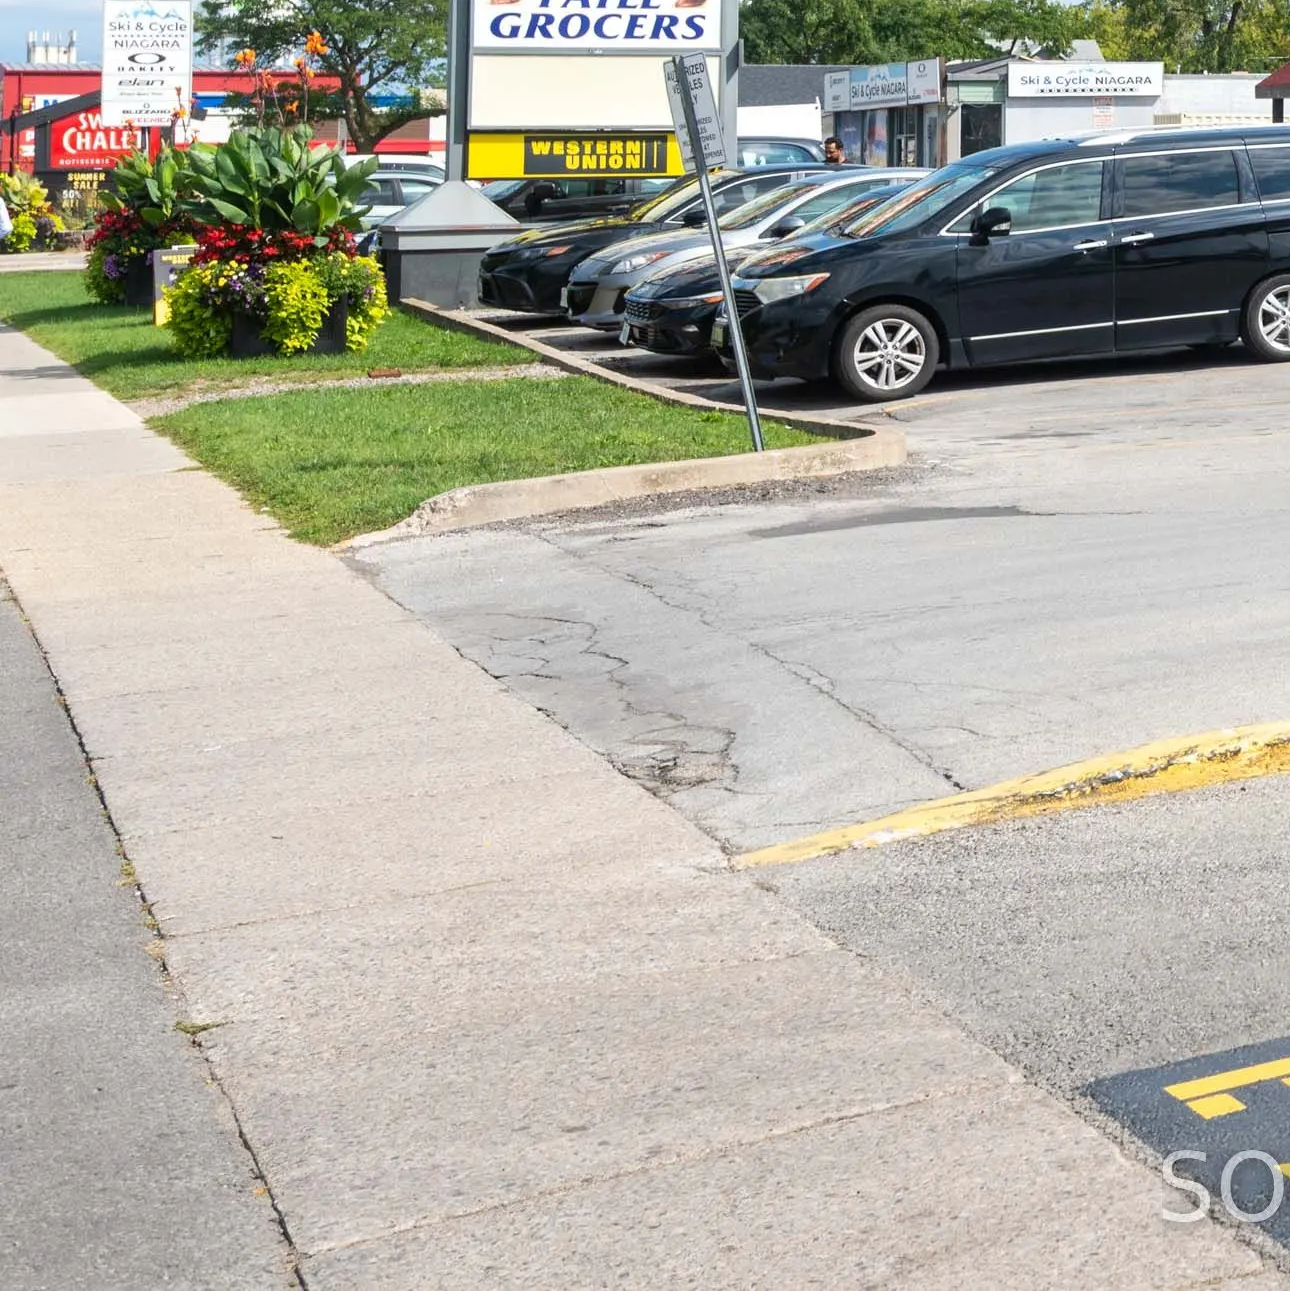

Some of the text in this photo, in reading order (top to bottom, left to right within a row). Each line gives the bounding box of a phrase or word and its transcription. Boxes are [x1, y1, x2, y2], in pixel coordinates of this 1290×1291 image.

[109, 21, 188, 33] Ski & Cycle
[490, 12, 706, 40] GROCERS
[114, 39, 181, 49] NIAGARA
[1020, 75, 1152, 87] Ski & Cycle NIAGARA
[851, 83, 860, 98] Ski
[865, 82, 881, 99] Cycle
[881, 81, 906, 96] NIAGARA
[531, 140, 641, 156] WESTERN
[565, 154, 641, 169] UNION
[73, 181, 99, 190] SALE
